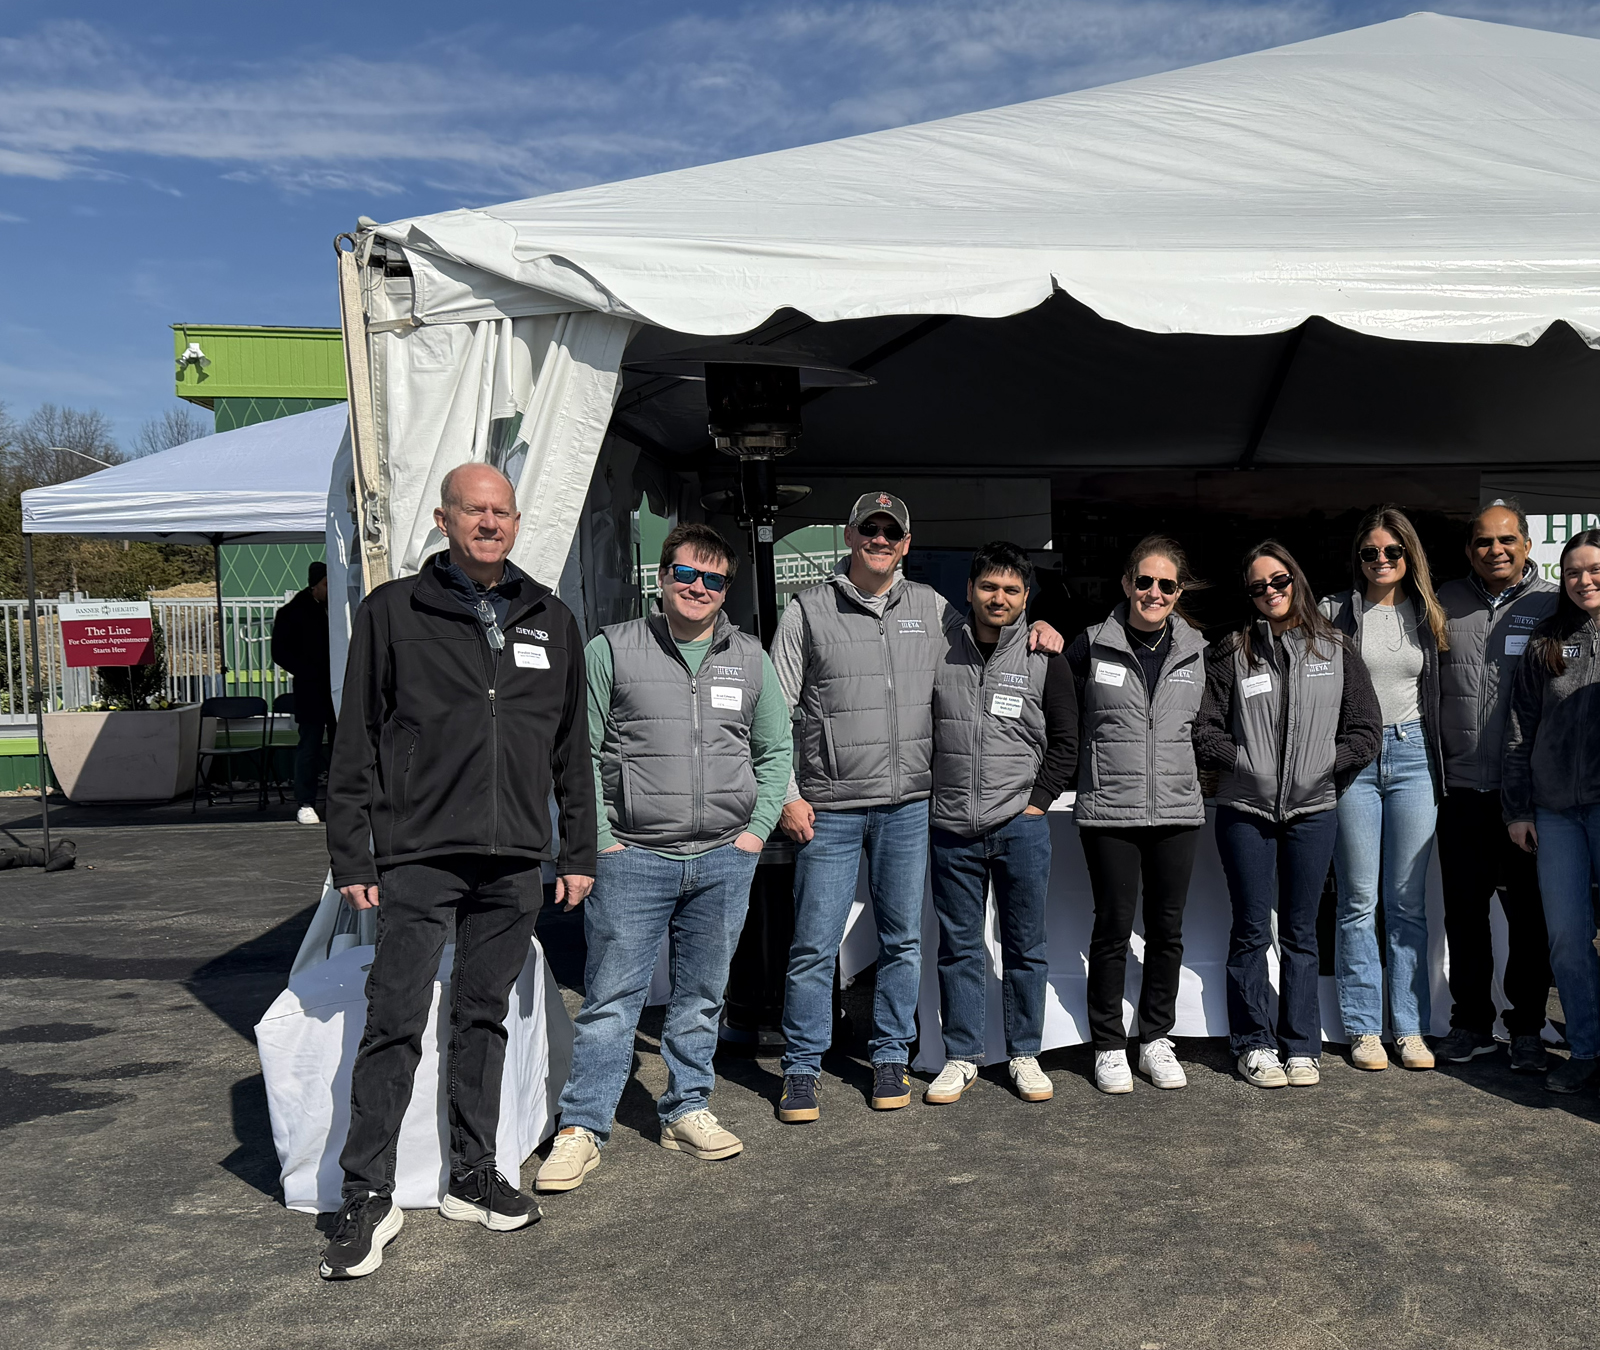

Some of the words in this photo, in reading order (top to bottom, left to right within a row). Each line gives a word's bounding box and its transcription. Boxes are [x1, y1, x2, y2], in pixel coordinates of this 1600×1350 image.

[84, 626, 106, 636] The
[108, 625, 131, 635] Line
[108, 637, 149, 645] Appointments
[1562, 649, 1580, 658] EYA
